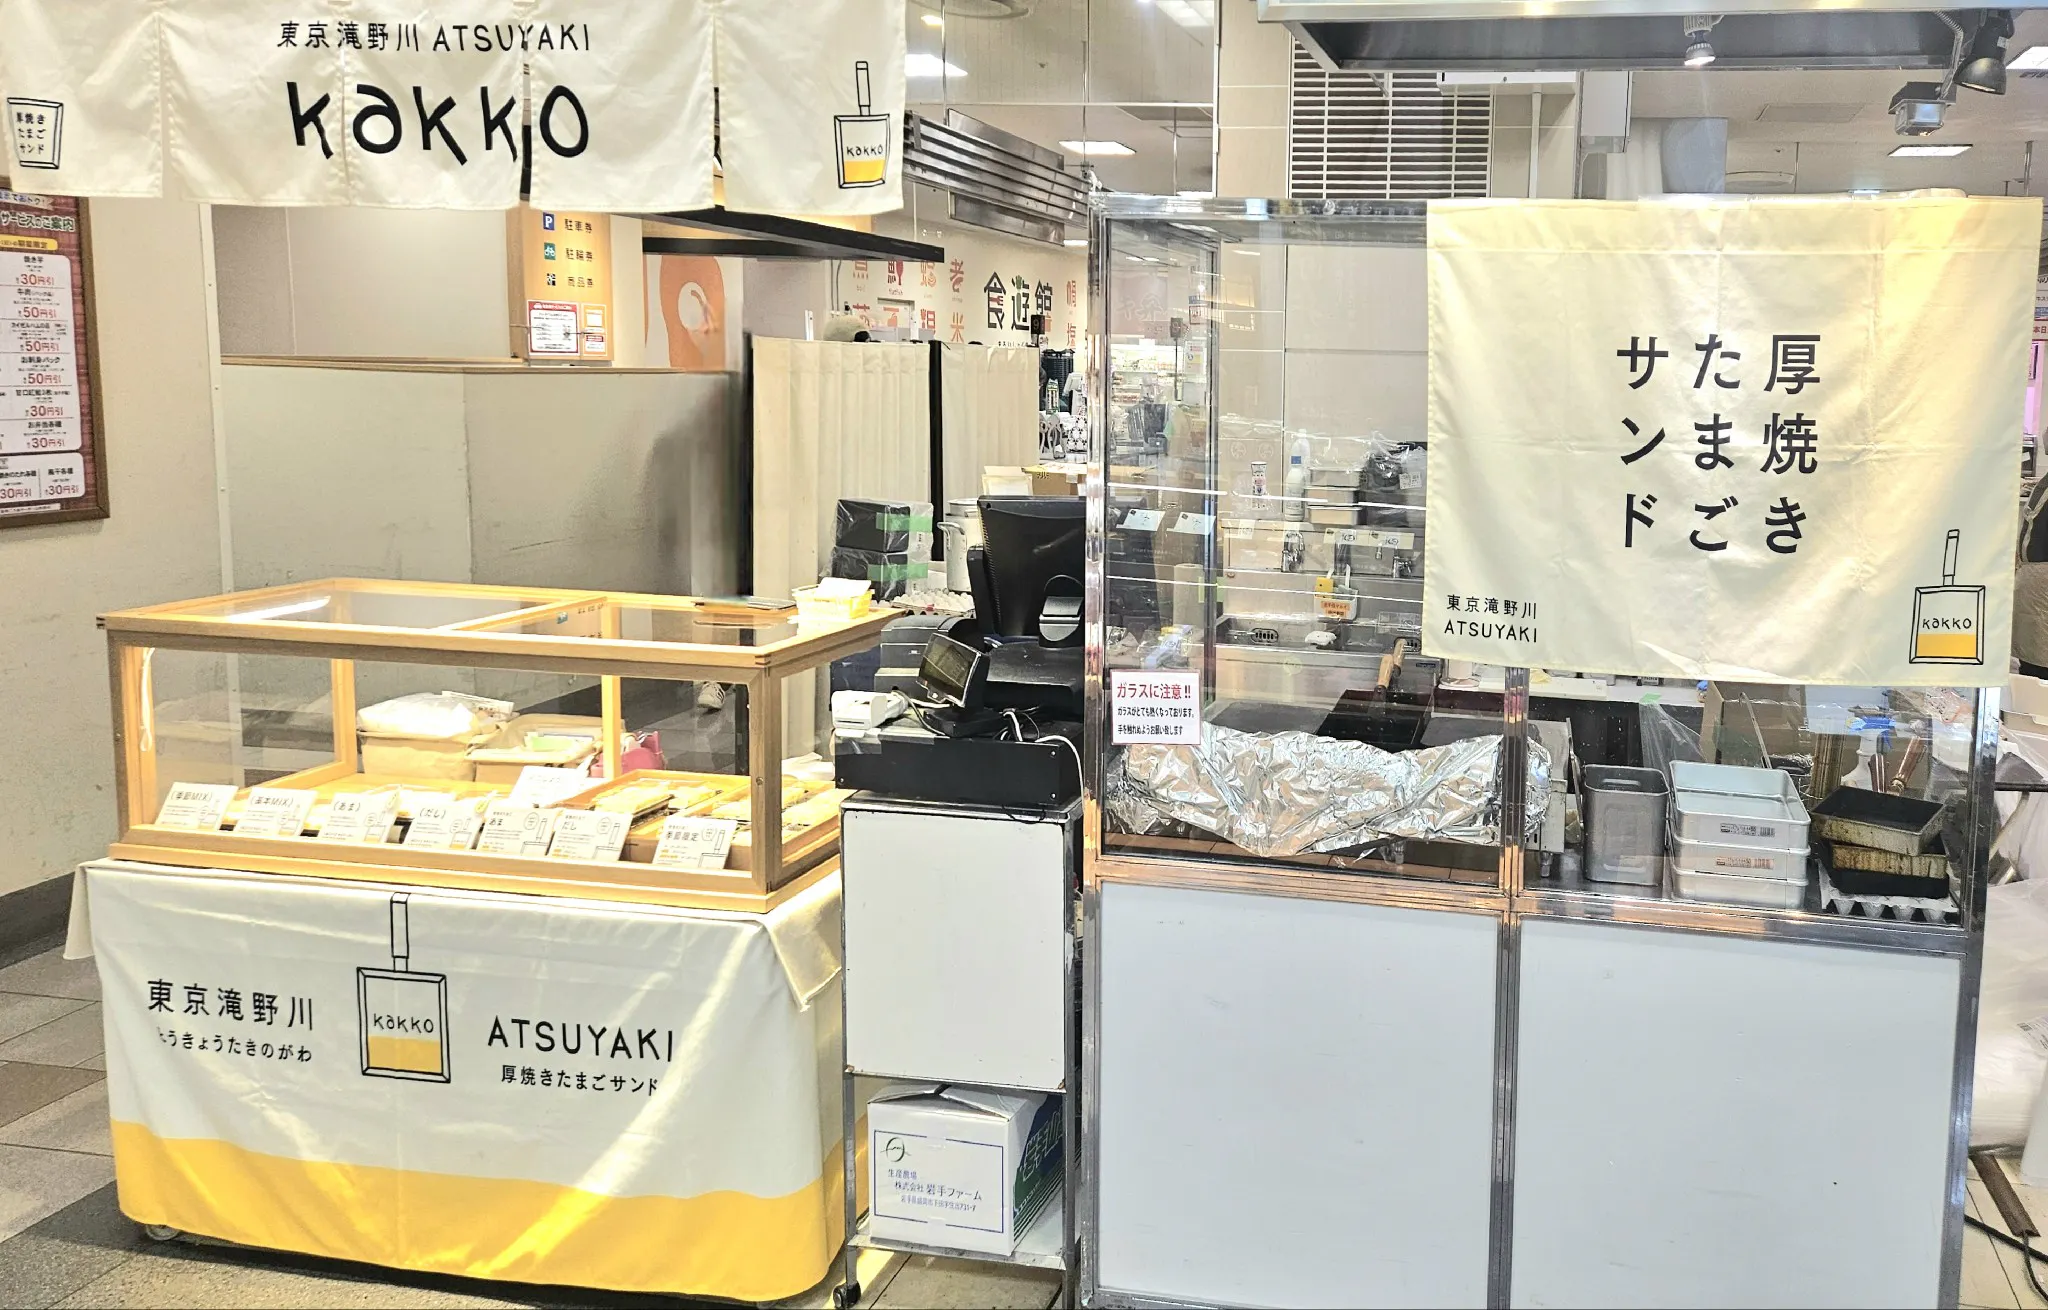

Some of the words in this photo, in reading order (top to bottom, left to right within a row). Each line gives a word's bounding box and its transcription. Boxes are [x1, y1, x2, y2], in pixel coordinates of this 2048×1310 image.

[277, 20, 419, 52] 東京滝野川
[432, 23, 590, 52] ATSUYAKI
[286, 81, 589, 166] kakko
[846, 144, 884, 157] kakko
[1616, 335, 1669, 548] サンド
[1689, 333, 1742, 552] たまご
[1759, 334, 1821, 554] 厚焼き
[1446, 594, 1537, 620] 東京滝野川
[1922, 617, 1972, 630] kakko
[1444, 618, 1537, 643] ATSUYAKI
[147, 979, 313, 1032] 東京滝野川
[373, 1012, 434, 1034] kakko
[487, 1015, 673, 1063] ATSUYAKI
[501, 1064, 660, 1097] 厚焼きたまごサンド
